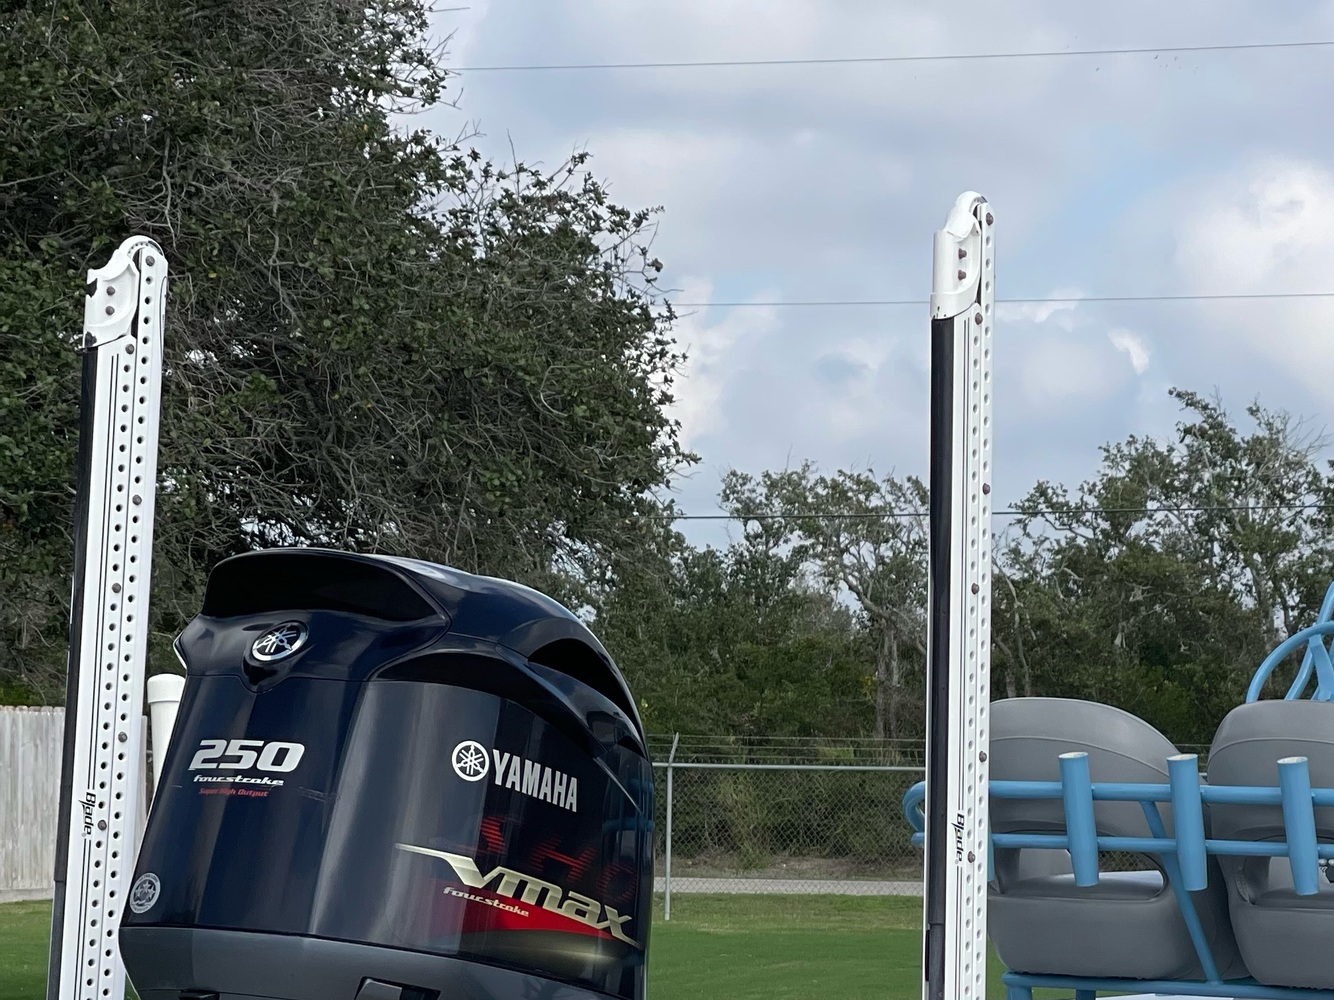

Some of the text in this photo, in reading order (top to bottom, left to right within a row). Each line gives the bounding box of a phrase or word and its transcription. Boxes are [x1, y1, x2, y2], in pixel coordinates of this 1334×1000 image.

[188, 739, 305, 773] 250
[193, 774, 285, 786] fourstroke
[237, 788, 270, 798] Output
[492, 749, 578, 812] YAMAHA
[78, 792, 97, 836] Blade
[951, 813, 965, 862] Blade
[443, 886, 530, 918] fourstroke
